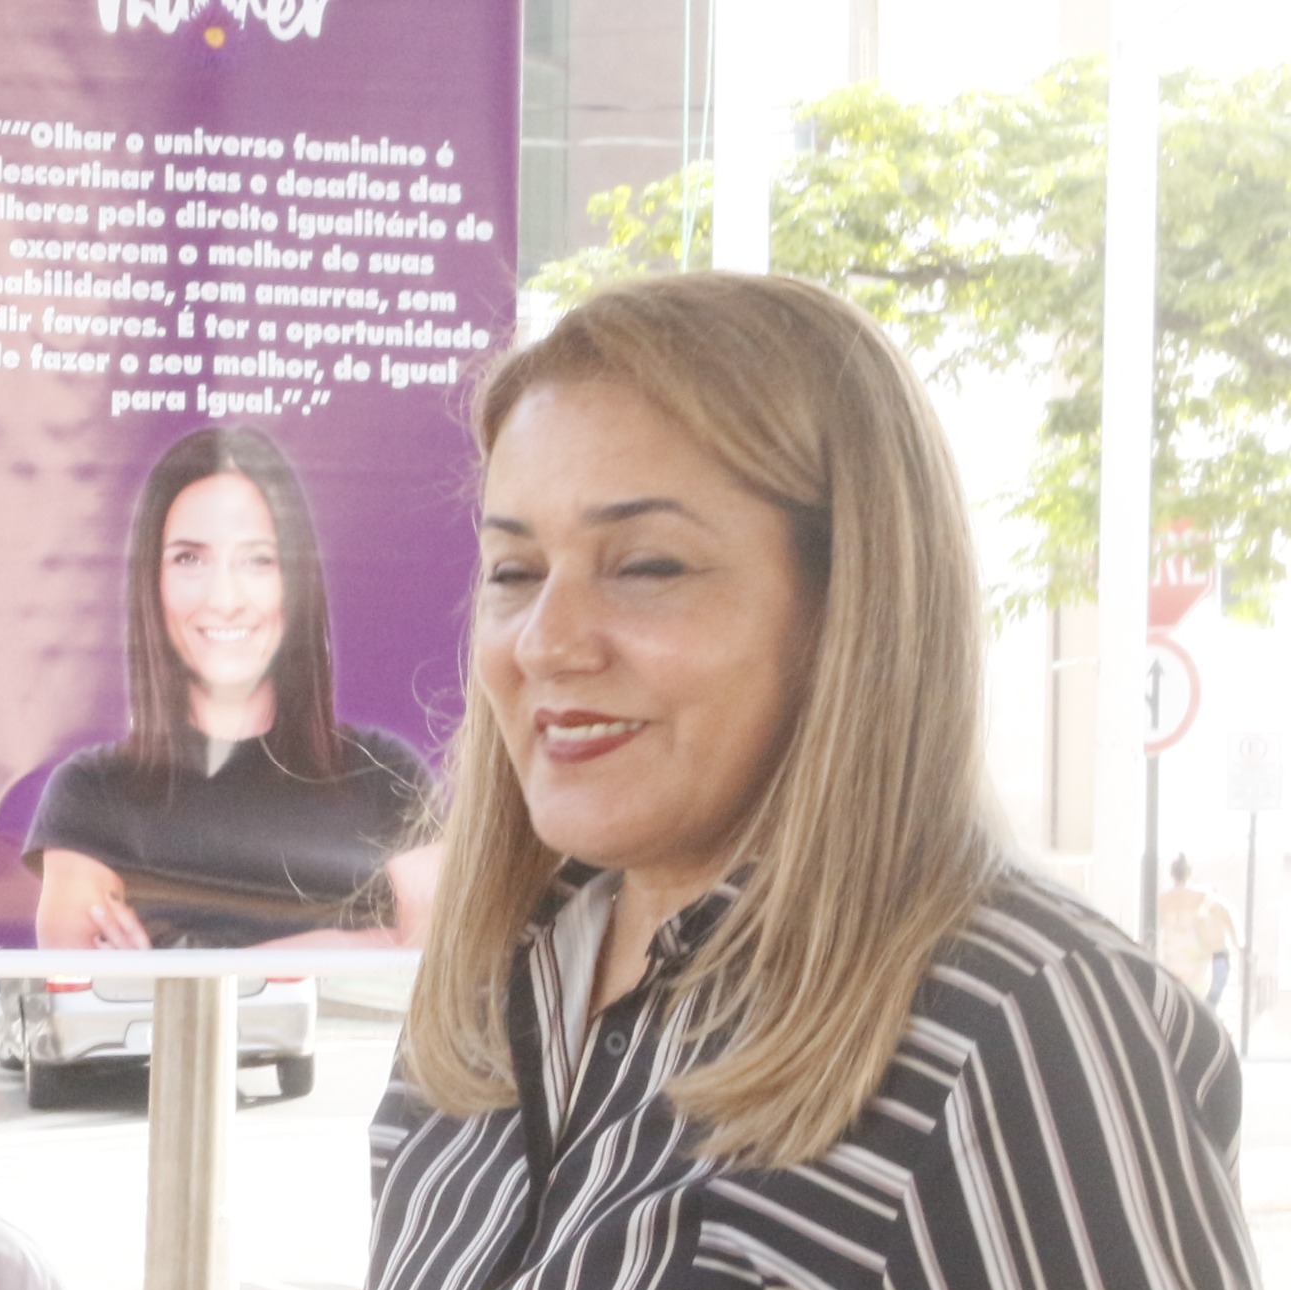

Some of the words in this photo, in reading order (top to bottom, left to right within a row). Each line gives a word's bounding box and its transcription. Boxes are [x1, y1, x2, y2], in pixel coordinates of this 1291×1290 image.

[126, 132, 144, 153] o
[155, 127, 284, 159] universo
[293, 132, 426, 166] feminino
[436, 140, 454, 168] é
[165, 164, 241, 193] lutas
[250, 174, 267, 195] e
[276, 168, 400, 200] desafios
[409, 175, 462, 205] das
[98, 200, 166, 232] pelo
[176, 200, 278, 232] direito
[288, 205, 447, 240] igualitário
[456, 212, 494, 242] de
[9, 238, 167, 265] exercerem
[178, 244, 198, 265] o
[208, 239, 313, 270] melhor
[322, 244, 359, 272] de
[369, 253, 435, 276] suas
[185, 281, 246, 303] sem
[255, 283, 389, 315] amarras,
[398, 290, 457, 312] sem
[42, 306, 167, 338] favores.
[177, 304, 195, 338] É
[205, 313, 250, 339] ter
[258, 320, 276, 341] a
[286, 318, 490, 350] oportunidade
[30, 342, 110, 373] fazer
[120, 353, 139, 374] o
[148, 354, 203, 375] seu
[213, 349, 324, 385] melhor,
[334, 353, 371, 381] de
[381, 354, 458, 390] igual
[111, 389, 186, 417] para
